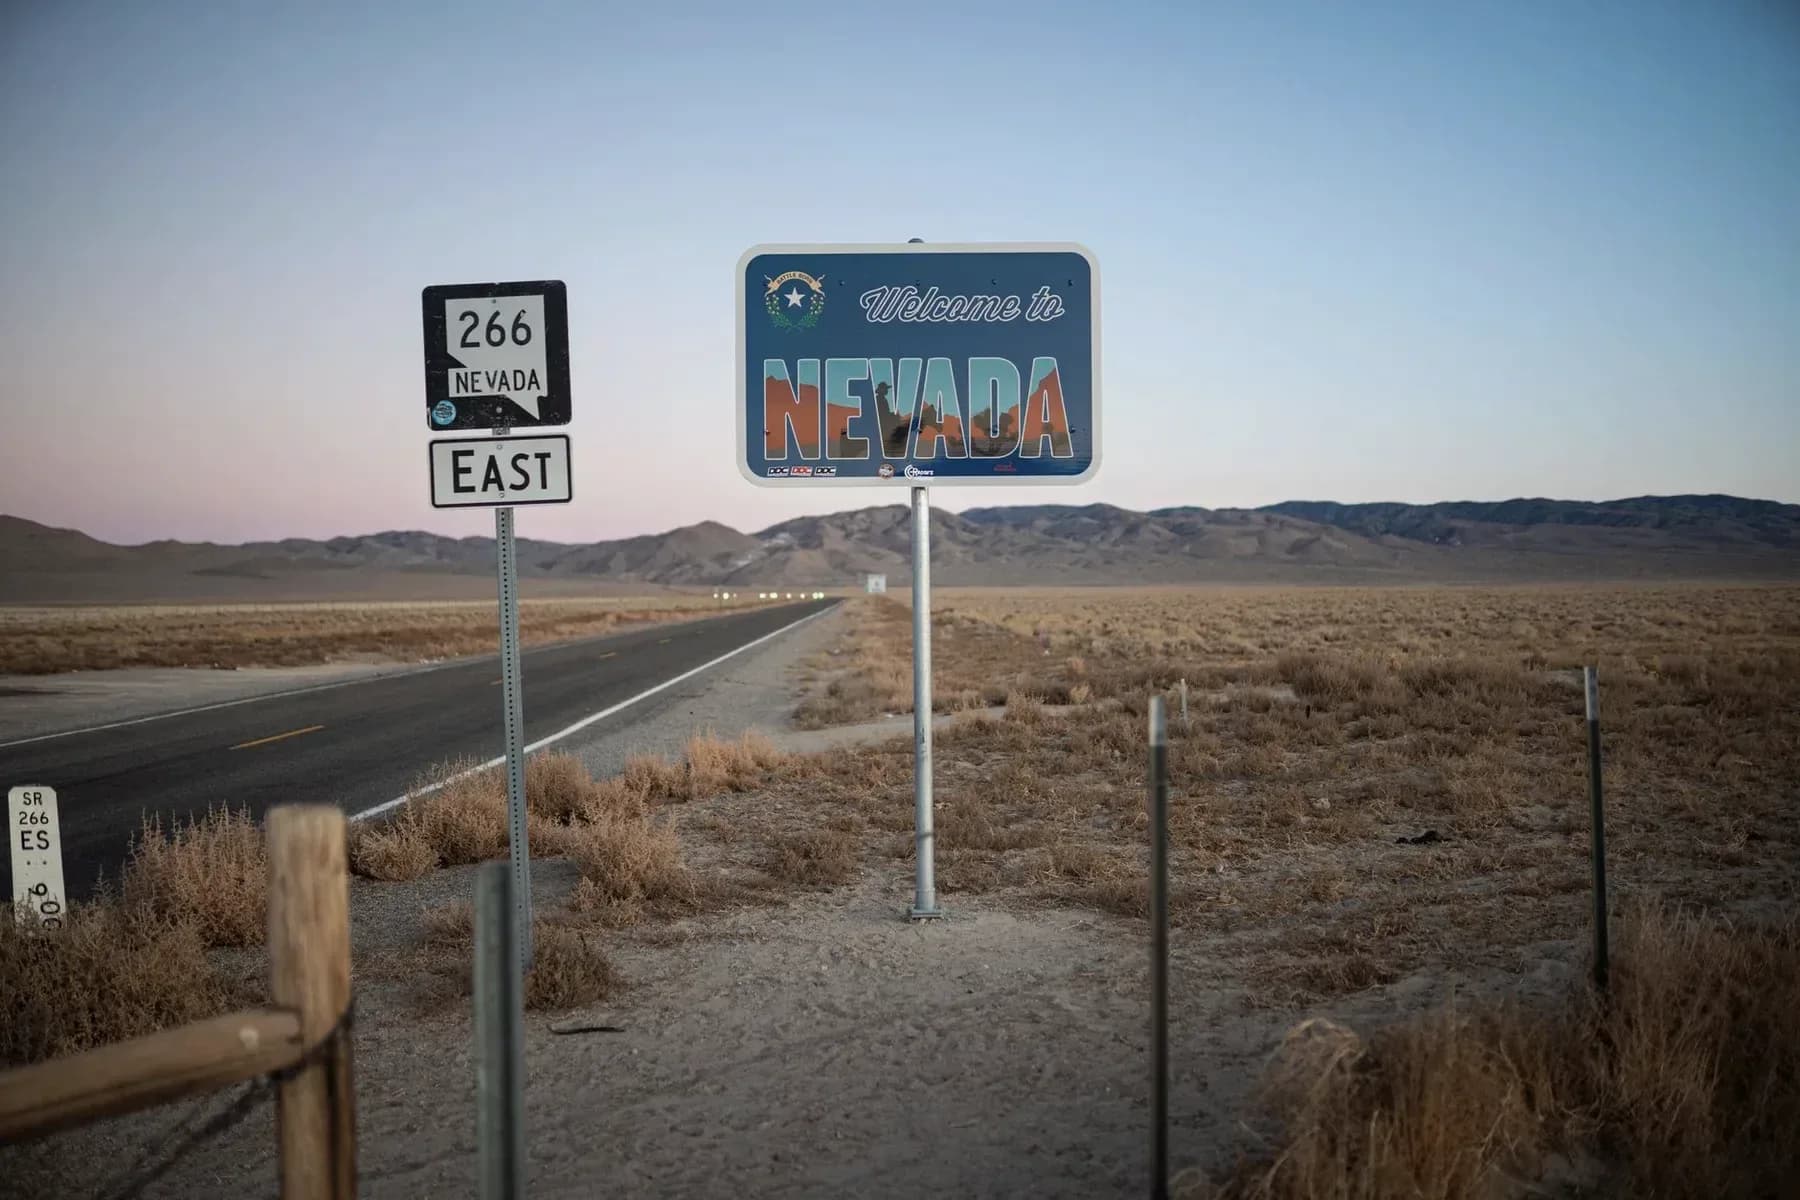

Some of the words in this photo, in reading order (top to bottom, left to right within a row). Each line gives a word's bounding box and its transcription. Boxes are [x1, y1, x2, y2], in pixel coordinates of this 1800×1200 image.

[860, 285, 1021, 323] Welcome
[1025, 285, 1065, 322] to
[458, 309, 532, 348] 266
[455, 368, 541, 394] NEVADA
[763, 356, 1074, 460] NEVADA
[451, 449, 552, 493] EAST
[23, 791, 43, 806] SR
[18, 811, 49, 825] 266
[21, 830, 50, 850] ES
